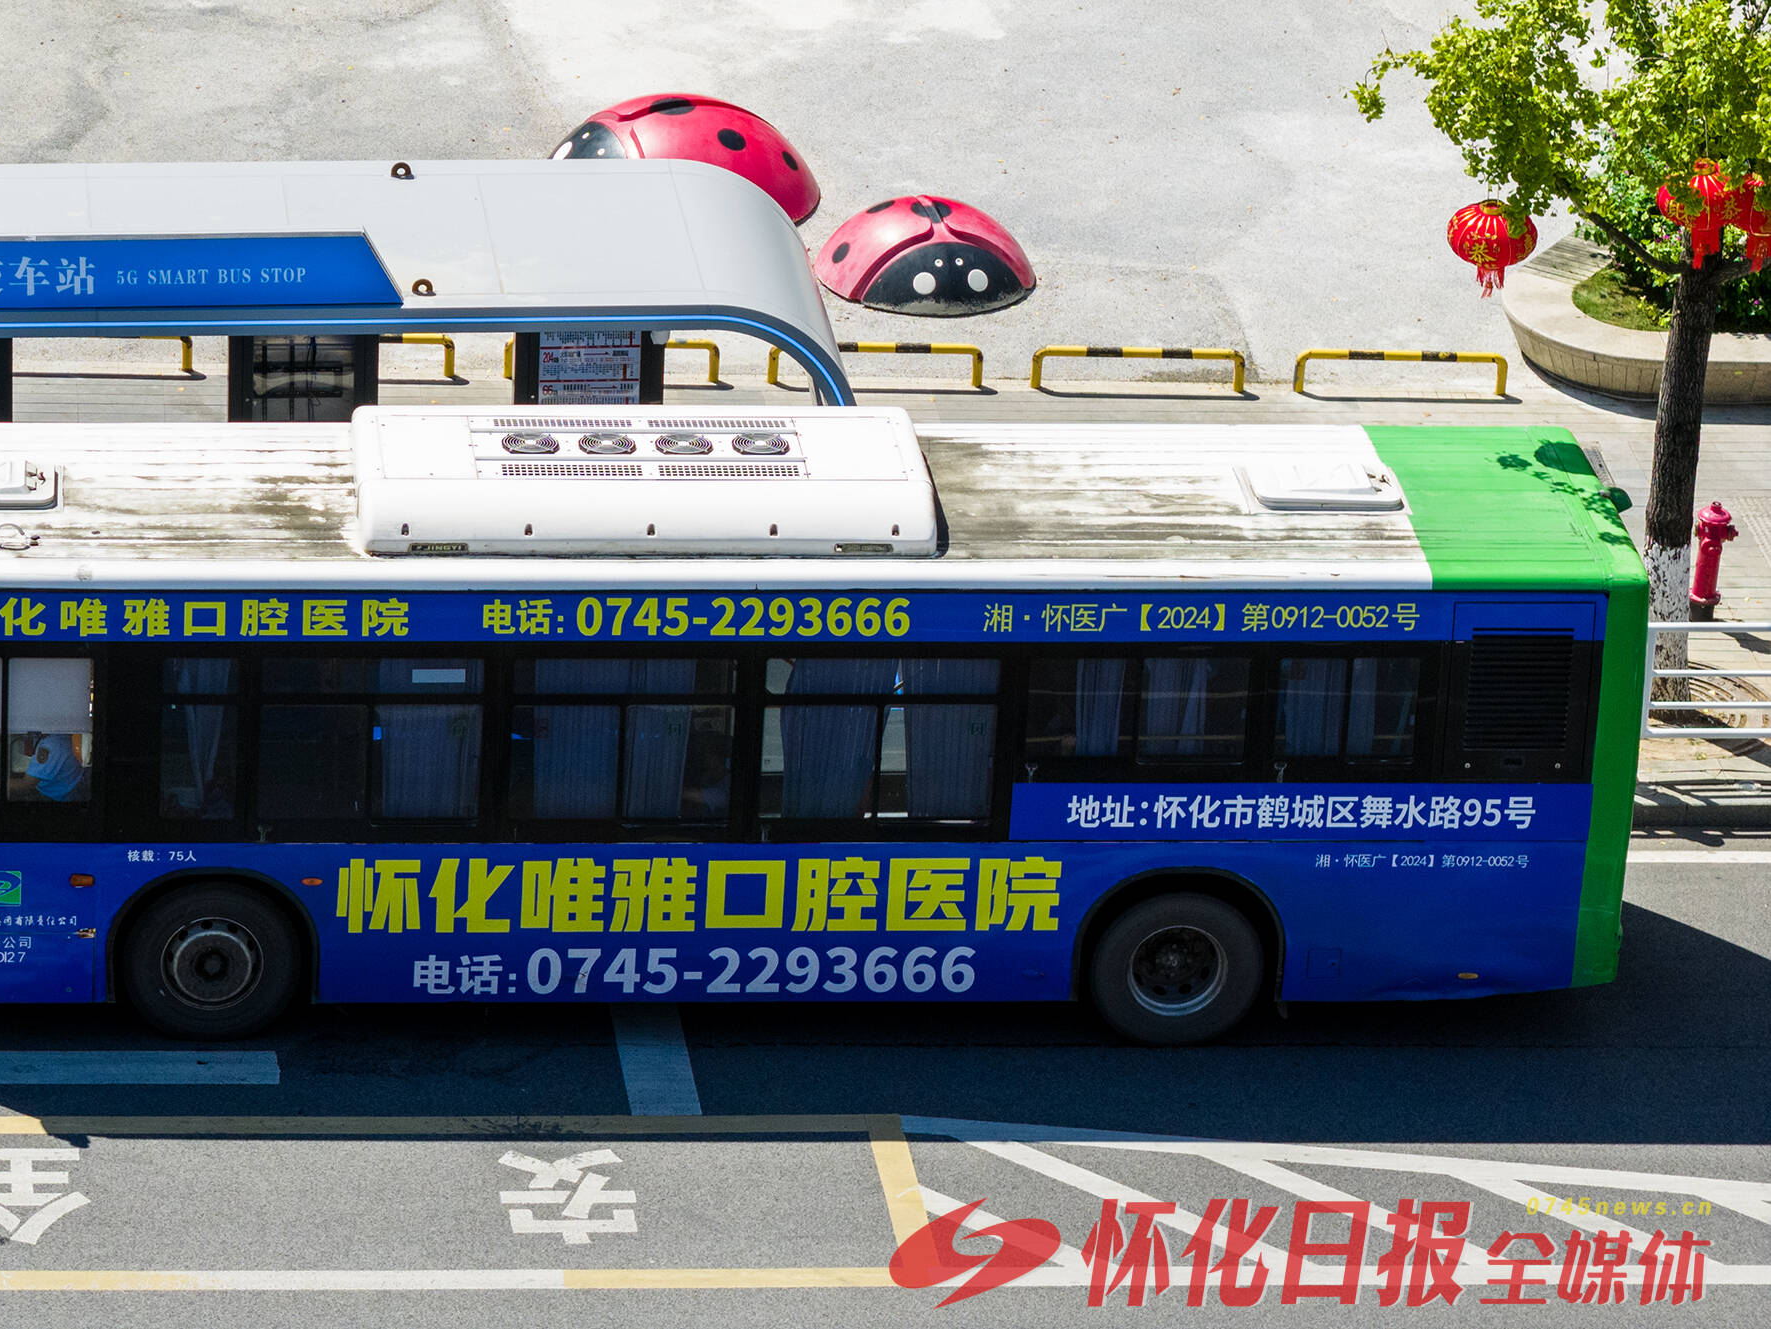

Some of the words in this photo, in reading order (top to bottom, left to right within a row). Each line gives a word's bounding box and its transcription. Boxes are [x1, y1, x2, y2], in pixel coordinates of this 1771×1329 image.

[116, 270, 138, 285] 5G
[148, 269, 209, 285] SMART
[218, 268, 251, 284] BUS
[260, 267, 306, 283] STOP
[482, 597, 911, 637] 电话:0745-2293666
[1067, 794, 1536, 830] 地址:怀化市鹤城区舞水路95号
[336, 857, 1062, 933] 怀化唯雅口腔医院
[413, 947, 976, 995] 电话:0745-2293666
